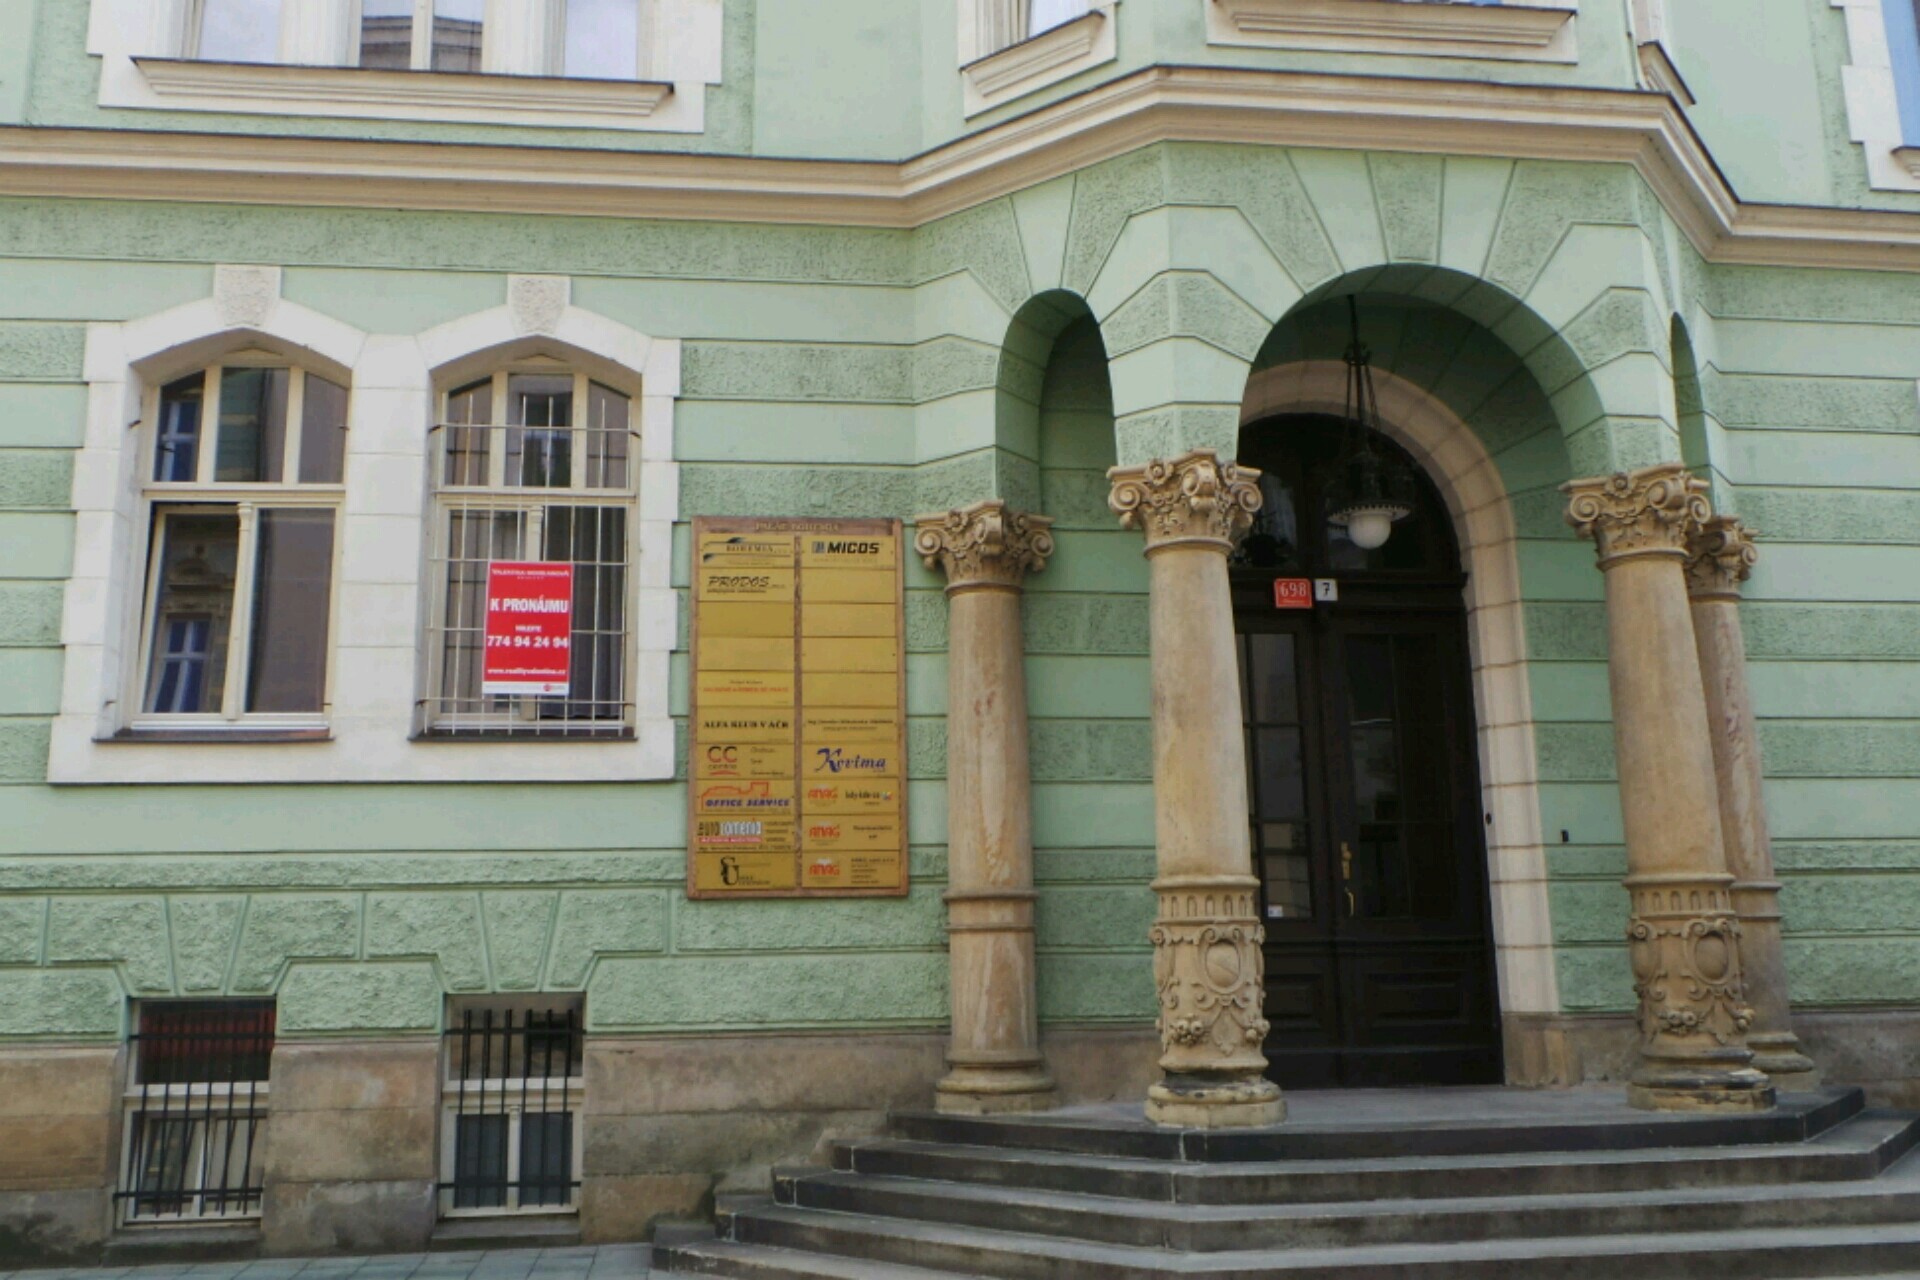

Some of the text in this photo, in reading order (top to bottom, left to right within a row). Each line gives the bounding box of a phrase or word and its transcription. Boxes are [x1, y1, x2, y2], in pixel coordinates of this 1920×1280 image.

[827, 541, 880, 554] MICOS
[708, 576, 770, 588] PRODOS
[1322, 582, 1331, 596] 7
[1280, 582, 1306, 597] 698
[490, 595, 568, 613] K PRONÁJMU
[488, 635, 568, 649] 774 94 24 94
[707, 745, 738, 763] CC
[705, 799, 790, 807] OFFICE SERVICE
